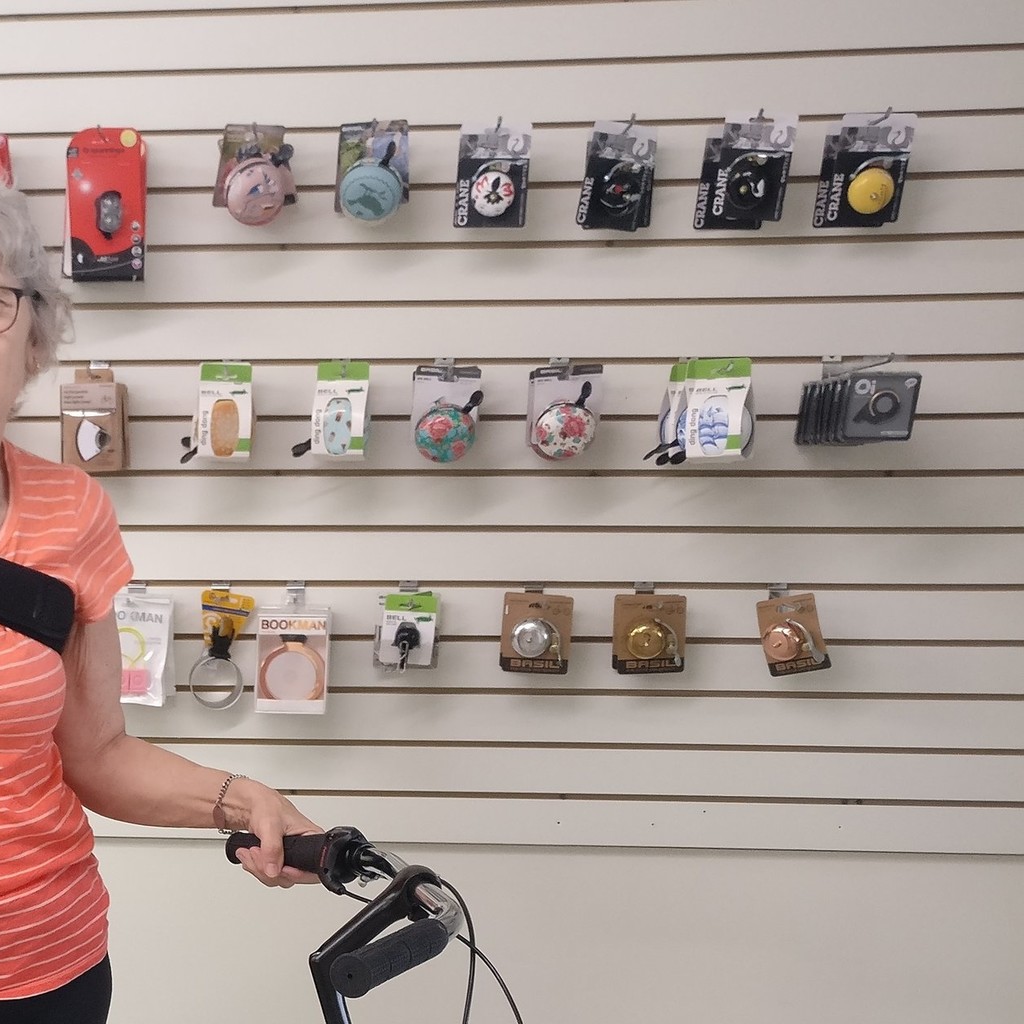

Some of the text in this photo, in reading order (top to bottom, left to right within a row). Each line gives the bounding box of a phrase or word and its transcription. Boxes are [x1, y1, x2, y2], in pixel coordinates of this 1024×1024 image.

[457, 179, 470, 226] CRANE
[576, 177, 594, 223] CRANE
[694, 182, 710, 228] CRANE
[712, 168, 728, 216] CRANE
[814, 180, 829, 227] CRANE
[827, 173, 845, 221] CRANE
[855, 378, 876, 395] Oi
[261, 619, 326, 630] BOOKMAN
[510, 659, 560, 669] BASIL
[625, 660, 676, 669] BASIL
[775, 658, 817, 671] BASIL
